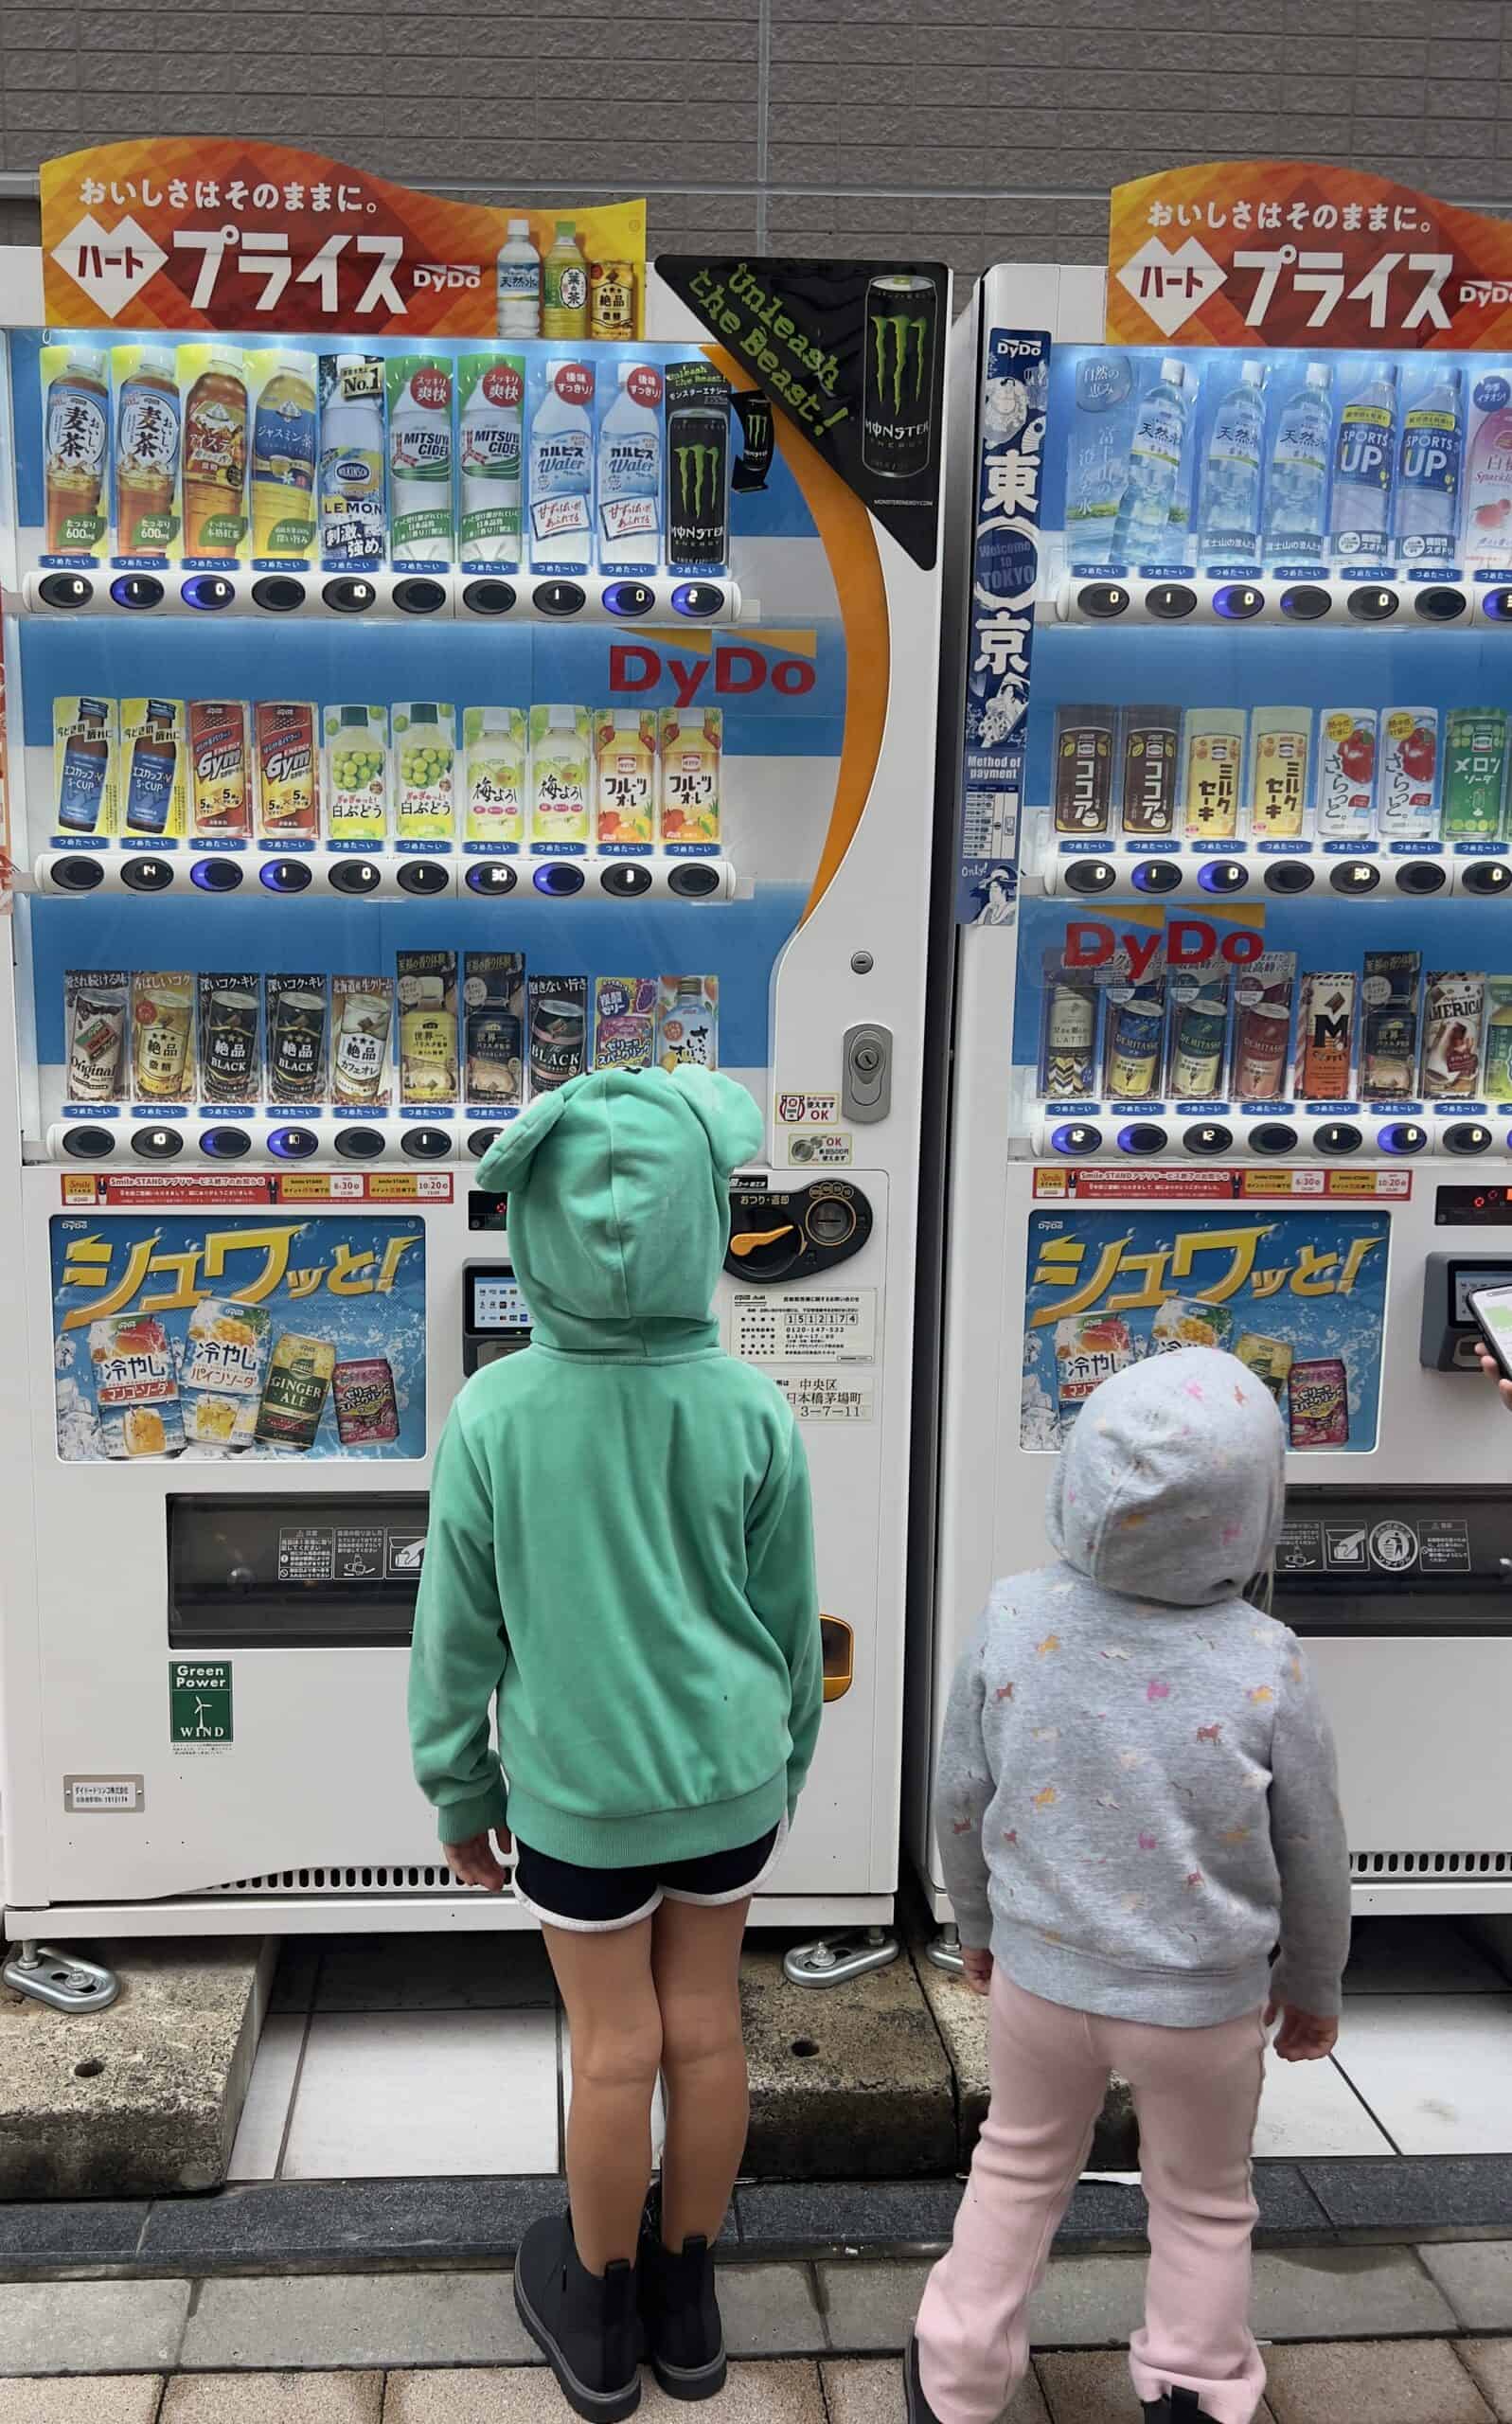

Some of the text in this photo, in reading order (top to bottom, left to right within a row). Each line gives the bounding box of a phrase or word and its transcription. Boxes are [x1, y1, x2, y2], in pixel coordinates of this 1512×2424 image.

[80, 178, 379, 215] おいしさはそのままに。
[1147, 201, 1431, 233] おいしさはそのままに。
[78, 245, 144, 279] ハート
[174, 224, 409, 314] プライス
[413, 270, 481, 293] DyDo
[500, 276, 537, 288] 天然水
[568, 272, 580, 305] 葉の茶
[1140, 266, 1203, 298] ハート
[1232, 244, 1453, 330] プライス
[600, 294, 625, 307] 絶品
[689, 269, 741, 333] the
[728, 263, 841, 398] Unleash
[998, 343, 1041, 357] DyDo
[418, 388, 447, 402] 爽快
[489, 387, 519, 401] 爽快
[61, 406, 90, 458] 麦茶
[133, 406, 162, 458] 麦茶
[258, 425, 312, 449] ジャスミン茶
[1343, 431, 1389, 447] SPORTS
[540, 446, 584, 458] カルピス
[1406, 435, 1452, 451] SPORTS
[611, 447, 653, 460] カルピス
[1340, 443, 1383, 472] UP
[1404, 448, 1448, 477] UP
[538, 457, 585, 472] Water
[608, 458, 654, 473] Water
[981, 449, 1041, 516] 東
[325, 502, 382, 514] LEMON
[979, 541, 1031, 558] Welcome
[981, 565, 1035, 591] TOKYO
[973, 610, 1032, 675] 京
[609, 645, 816, 707] DyDo
[968, 755, 1022, 768] Method of
[1454, 758, 1501, 774] メロン
[969, 768, 1018, 779] payment
[604, 775, 648, 794] フルーツ
[668, 775, 713, 793] フルーツ
[1073, 760, 1094, 819] ココア
[1142, 760, 1162, 819] ココア
[1217, 763, 1233, 815] ミルク
[1284, 761, 1300, 811] ミルク
[1199, 780, 1216, 822] セーキ
[1266, 777, 1283, 819] セーキ
[332, 804, 382, 819] 白ぶどう
[400, 801, 452, 816] 白ぶどう
[1064, 920, 1264, 979] DyDo
[149, 1040, 178, 1057] 絶品
[215, 1040, 246, 1058] 絶品
[283, 1040, 312, 1058] 絶品
[347, 1042, 376, 1060] 絶品
[530, 1042, 579, 1067] BLACK
[71, 1056, 115, 1078] Original
[211, 1056, 246, 1072] BLACK
[278, 1058, 314, 1072] BLACK
[340, 1060, 379, 1076] カフェオレ
[810, 1110, 829, 1120] OK
[826, 1137, 842, 1147] OK
[61, 1223, 423, 1333] シュワッと!
[1028, 1224, 1386, 1328] シュワッと!
[788, 1315, 855, 1324] 1512174
[195, 1341, 257, 1371] 冷やし
[105, 1355, 166, 1382] 冷やし
[190, 1366, 258, 1389] パインソーダ
[109, 1382, 169, 1401] マンゴーソーダ
[271, 1375, 323, 1399] GINGER
[800, 1378, 838, 1391] 中央区
[280, 1393, 308, 1408] ALE
[787, 1392, 863, 1405] 日本橋茅場町
[177, 1665, 224, 1677] Green
[176, 1677, 226, 1688] Power
[180, 1726, 224, 1738] WIND
